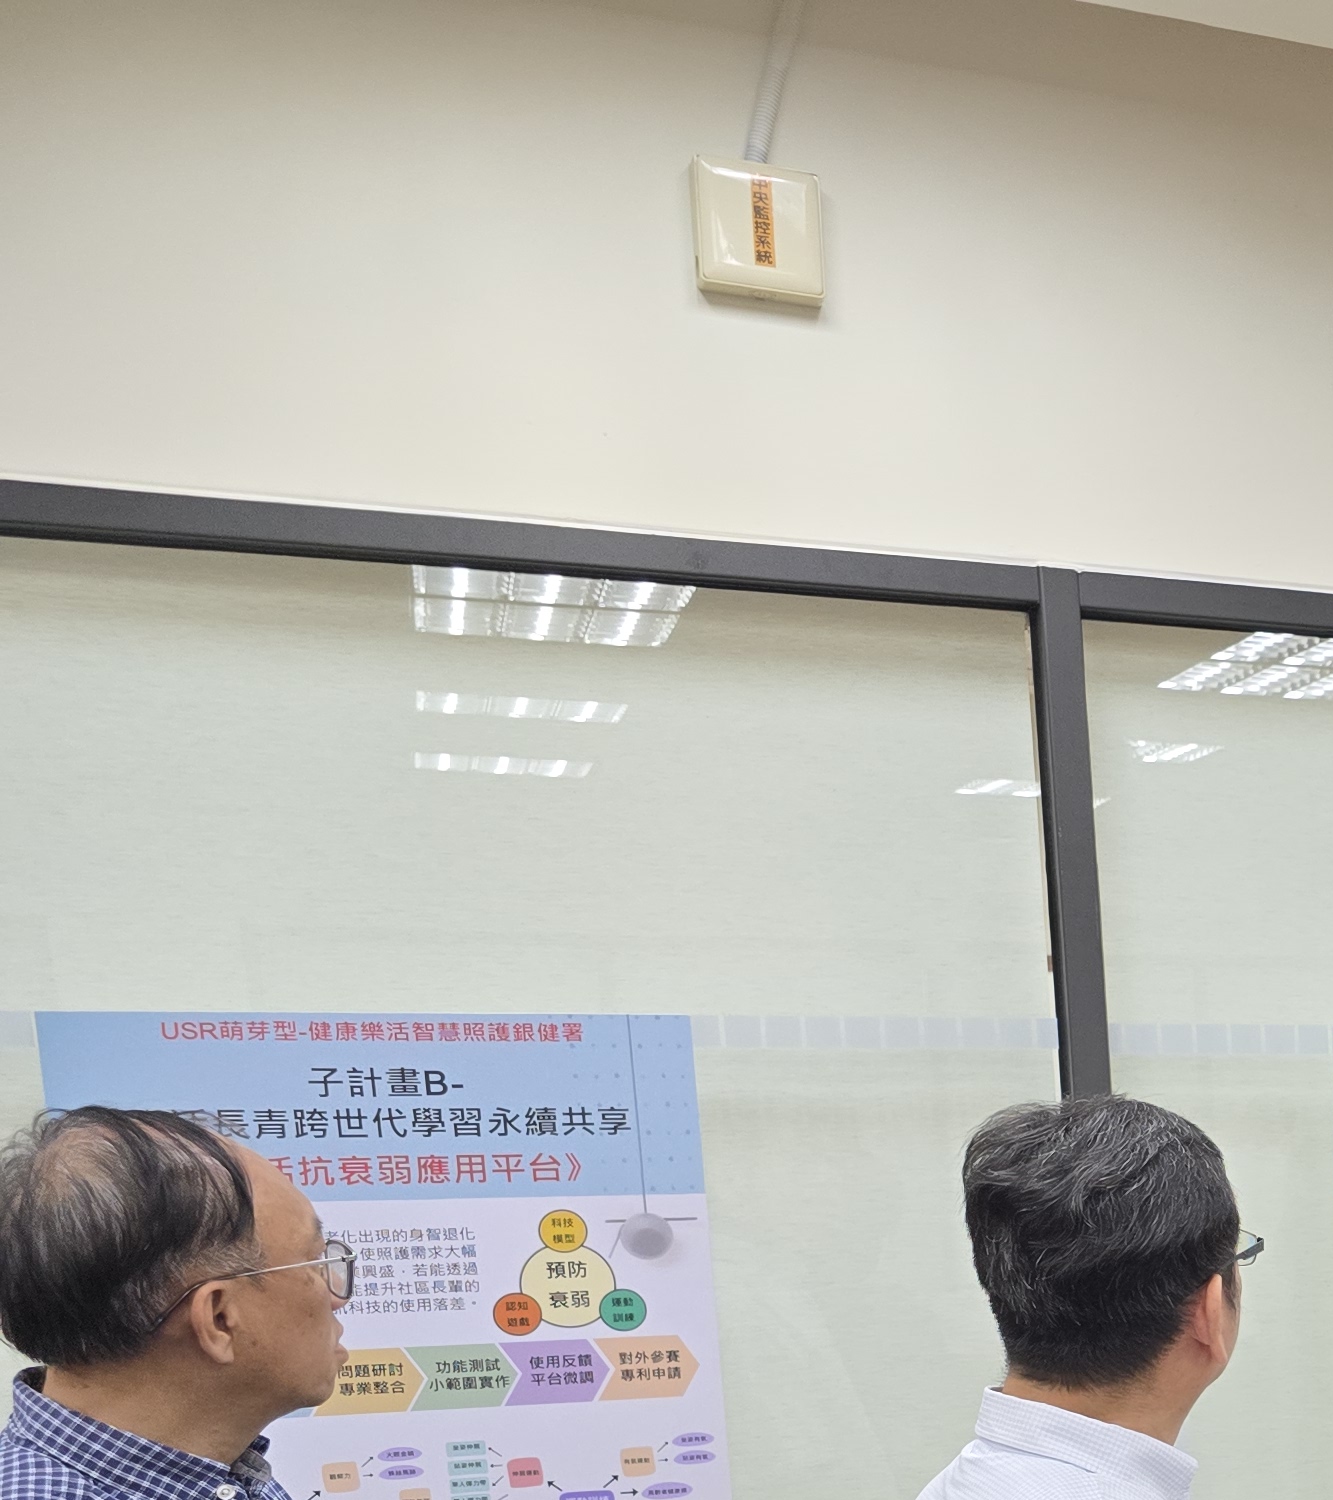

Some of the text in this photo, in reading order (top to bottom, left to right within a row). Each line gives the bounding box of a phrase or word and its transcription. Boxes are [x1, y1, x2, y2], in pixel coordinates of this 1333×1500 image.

[161, 1020, 583, 1041] USR萌芽型-健康樂活智慧照護銀健署
[308, 1067, 464, 1097] 子計畫B-
[180, 1106, 632, 1139] 長青跨世代學習永續共享
[546, 1261, 587, 1279] 預防
[506, 1301, 528, 1311] 認知
[549, 1290, 590, 1309] 衰弱
[612, 1297, 633, 1307] 運動
[529, 1353, 593, 1370] 使用反饋
[618, 1350, 680, 1365] 對外參賽
[337, 1363, 403, 1379] 問題研討
[435, 1358, 501, 1374] 功能測試
[621, 1366, 682, 1382] 專利申請
[429, 1375, 511, 1392] 小範圍實作
[531, 1371, 594, 1387] 平台微調
[339, 1381, 406, 1396] 專業整合
